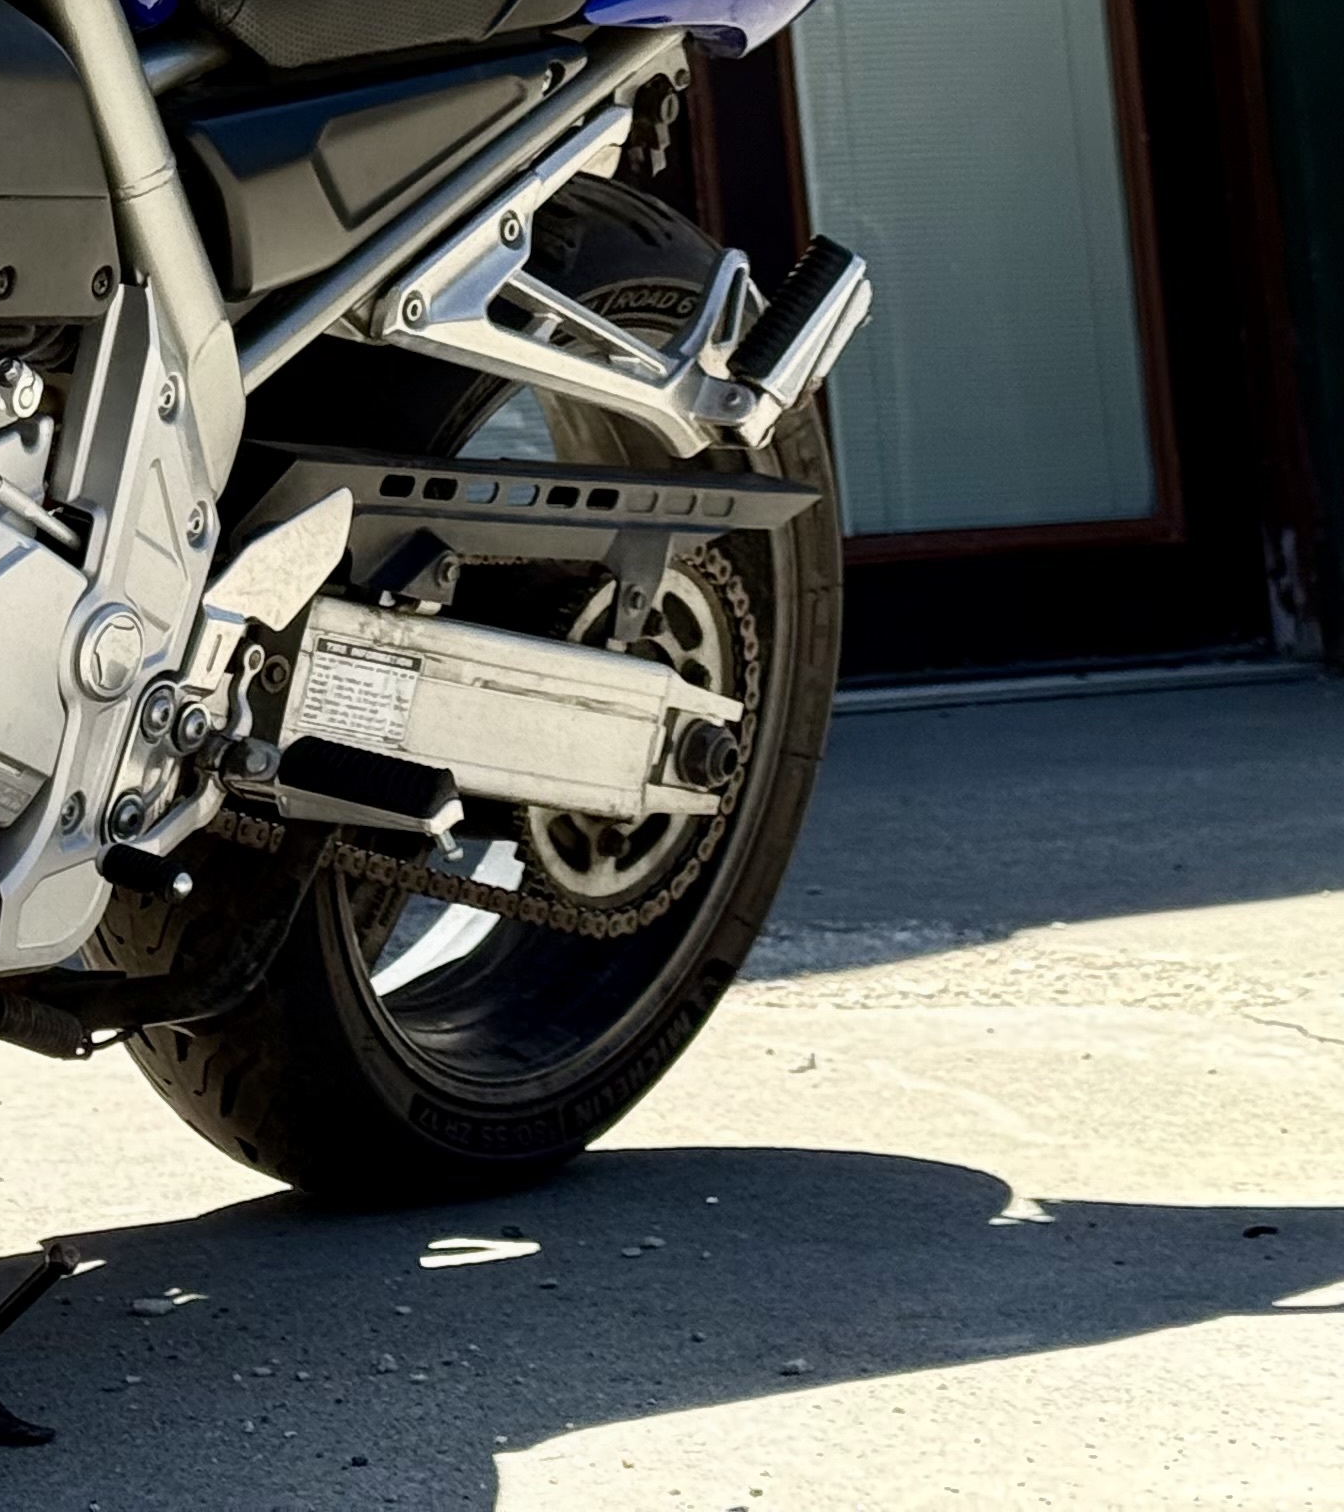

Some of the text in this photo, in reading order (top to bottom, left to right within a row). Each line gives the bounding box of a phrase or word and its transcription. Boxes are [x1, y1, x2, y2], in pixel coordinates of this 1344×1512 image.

[612, 289, 680, 310] ROAD
[675, 295, 699, 314] 6
[573, 1008, 695, 1127] MICHELIN
